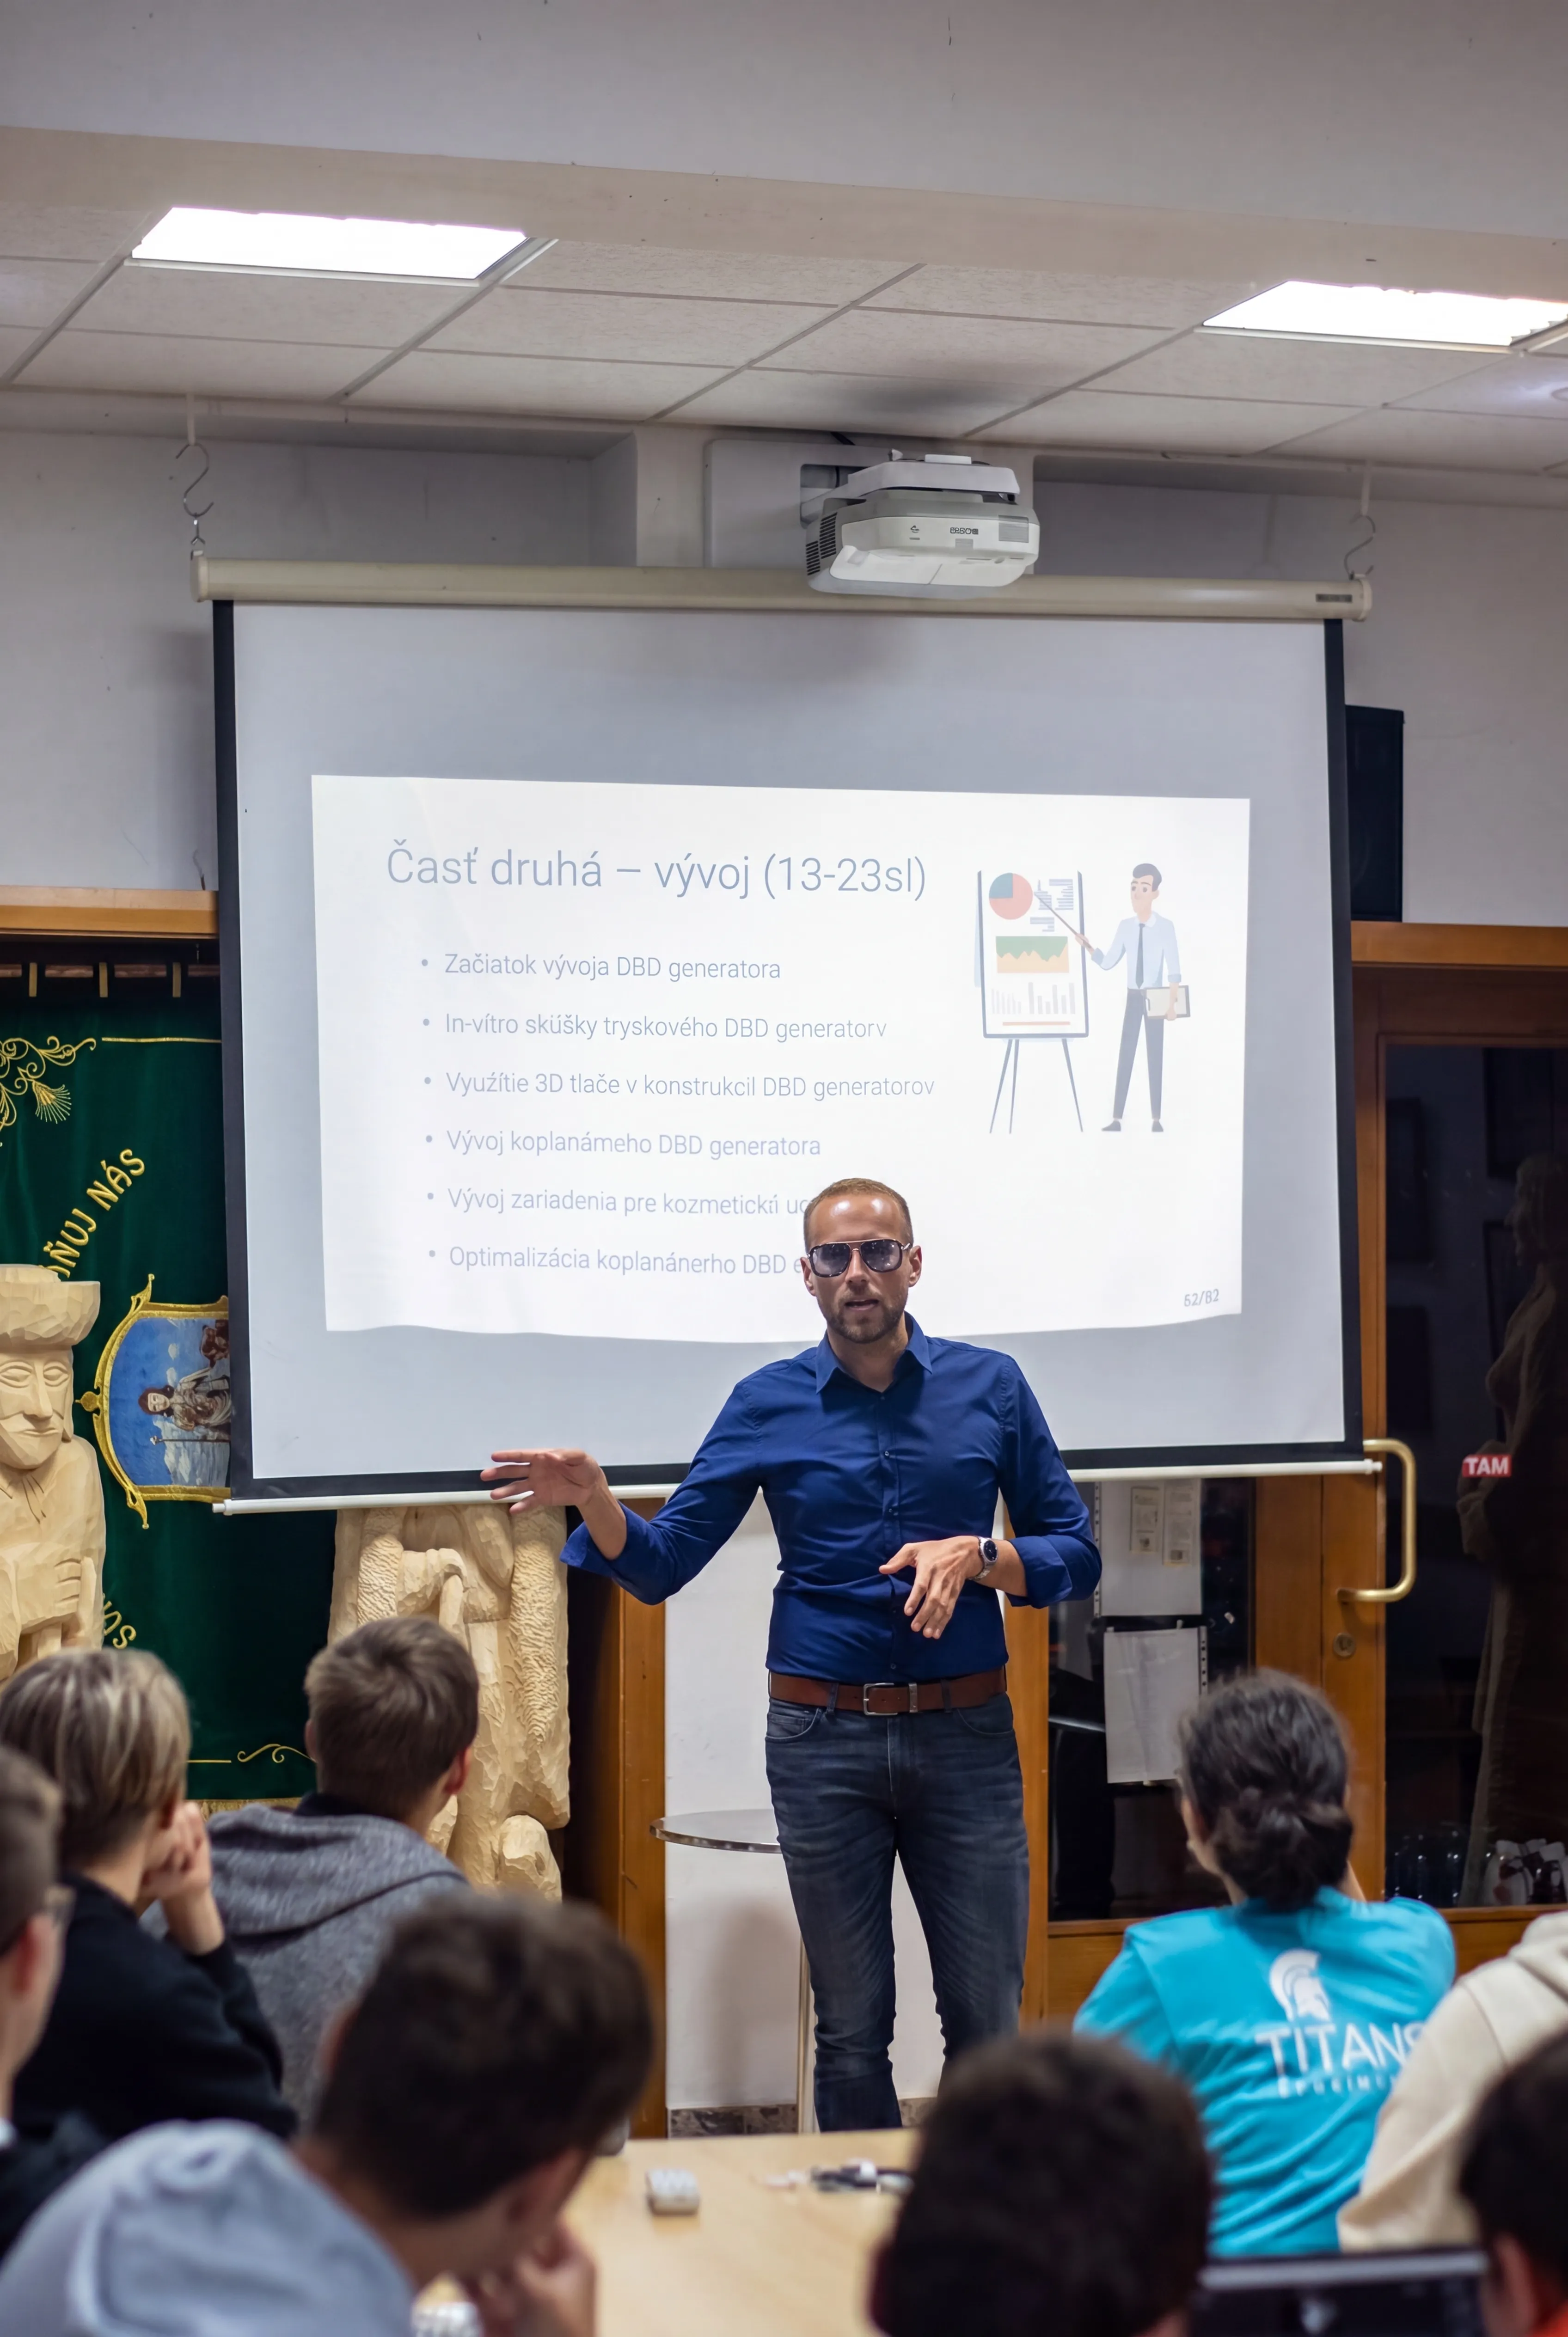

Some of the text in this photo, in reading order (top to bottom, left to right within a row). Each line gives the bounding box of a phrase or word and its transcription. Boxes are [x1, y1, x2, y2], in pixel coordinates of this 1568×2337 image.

[387, 838, 479, 885] Časť
[491, 848, 602, 887] druhá
[654, 852, 749, 899] vývoj
[764, 853, 925, 902] (13-23sl)
[445, 953, 780, 983] Začiatok vývoja DBD generatora
[603, 1015, 718, 1041] tryskového
[725, 1018, 768, 1038] DBD
[535, 1073, 563, 1093] 3D
[569, 1073, 620, 1094] tlače
[626, 1079, 637, 1094] v
[764, 1077, 806, 1096] DBD
[813, 1077, 935, 1101] generatorov
[446, 1129, 503, 1156] Vývoj
[659, 1134, 703, 1155] DBD
[710, 1137, 821, 1161] generatora
[86, 1148, 145, 1211] NÁS
[447, 1187, 504, 1214] Vývoj
[511, 1189, 617, 1211] zariadenia
[624, 1196, 657, 1217] pre
[449, 1246, 590, 1272] Optimalizácia
[743, 1254, 786, 1274] DBD
[1463, 1456, 1508, 1475] TAM
